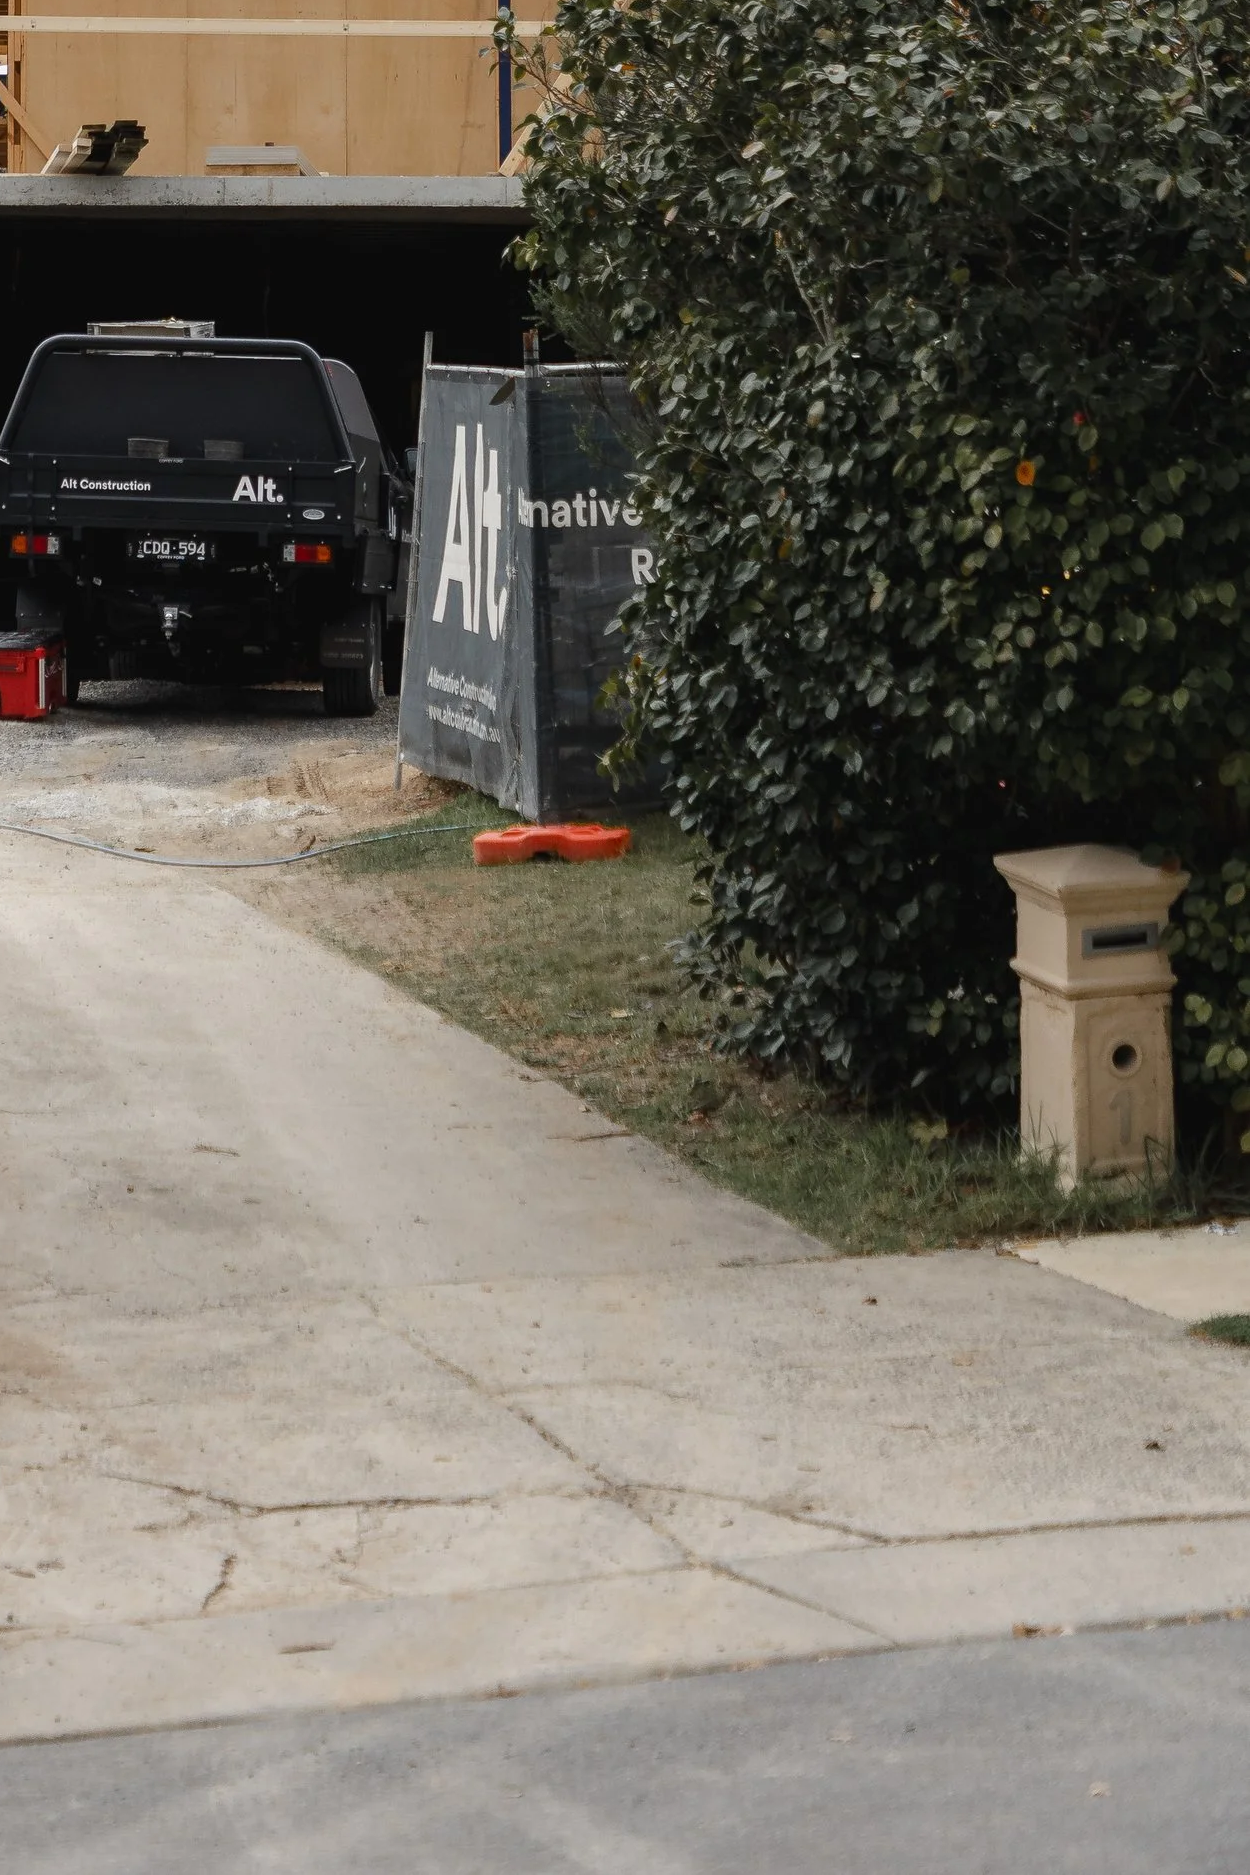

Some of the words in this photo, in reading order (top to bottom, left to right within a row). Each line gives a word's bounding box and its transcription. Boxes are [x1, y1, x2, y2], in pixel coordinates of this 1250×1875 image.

[60, 478, 78, 490] Alt
[79, 479, 151, 491] Construction
[232, 475, 284, 503] Alt.
[517, 486, 644, 528] native
